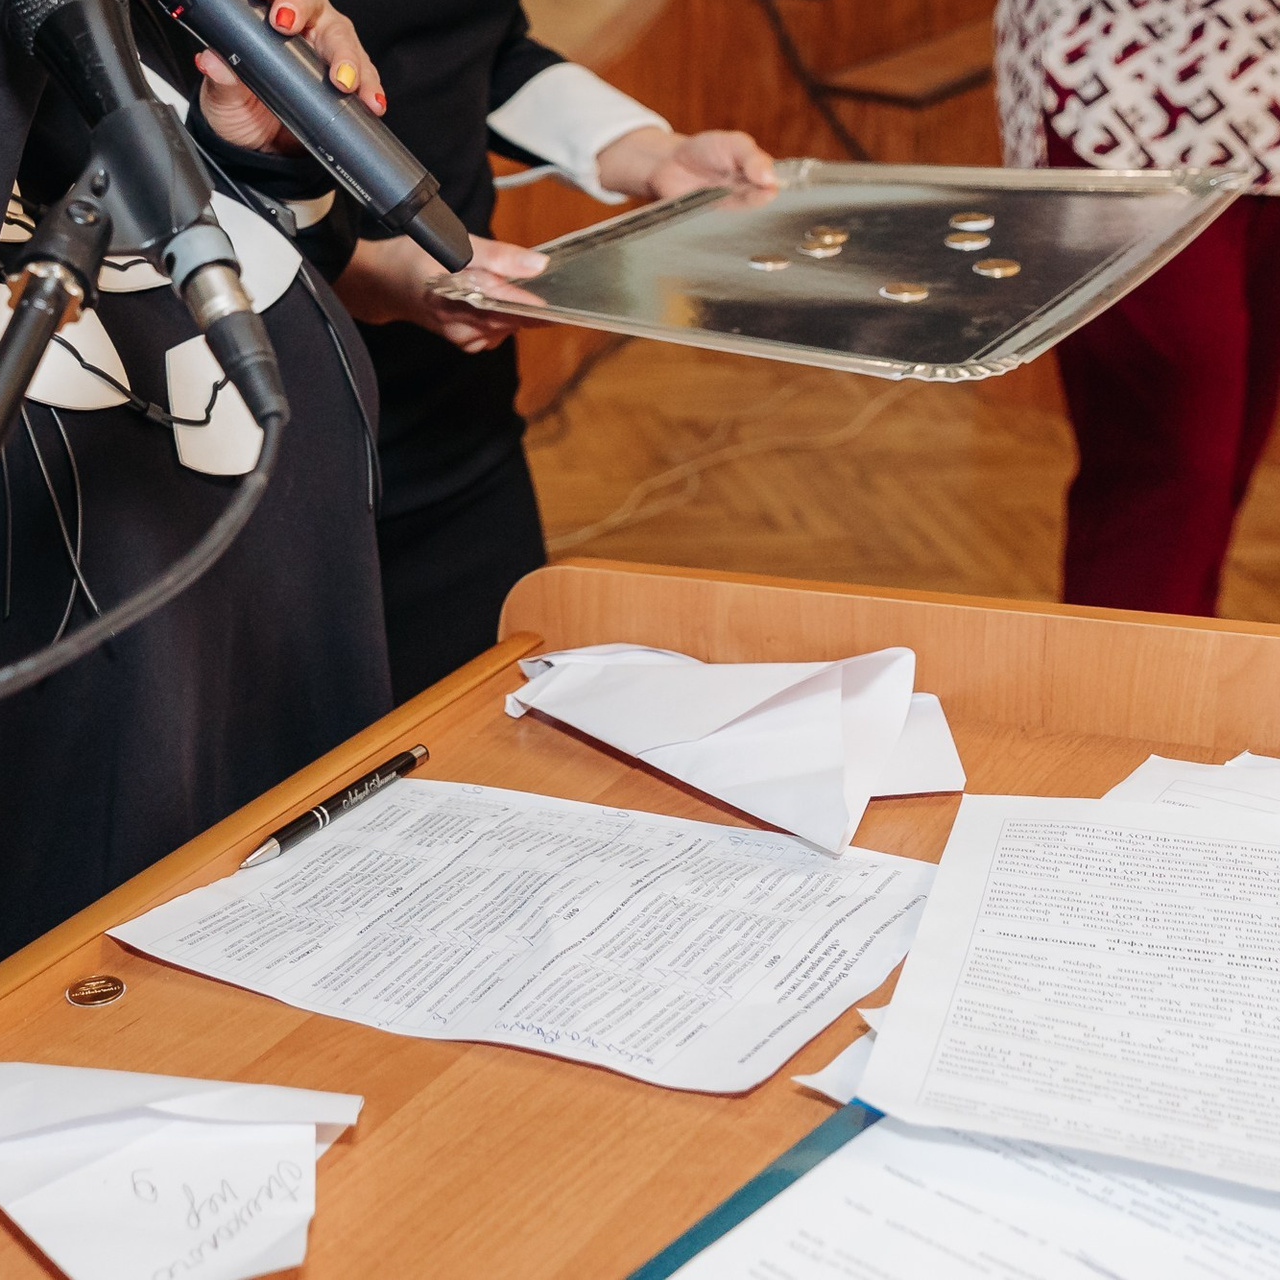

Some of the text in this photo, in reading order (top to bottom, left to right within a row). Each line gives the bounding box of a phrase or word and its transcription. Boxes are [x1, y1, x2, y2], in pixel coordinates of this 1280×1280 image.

[336, 164, 373, 202] SENNHEISER
[1008, 821, 1101, 833] «Нижегородский
[1006, 827, 1216, 853] начального образования факультета
[1128, 833, 1169, 843] ФГБОУ
[1173, 837, 1236, 848] педагогики
[1005, 833, 1252, 866] кафедры психологии педагогики
[1043, 849, 1111, 863] университет
[1063, 845, 1151, 861] педагогических
[999, 852, 1095, 870] «Нижегородский
[1118, 860, 1209, 876] педагогический
[1156, 857, 1207, 867] кандидат
[997, 858, 1213, 889] начального образования факультета
[1122, 869, 1165, 879] ФГБОУ
[1169, 873, 1234, 884] педагогики
[996, 866, 1250, 903] кафедры психологии педагогики
[1033, 892, 1104, 906] университет
[1090, 892, 1142, 904] кандидат
[562, 907, 581, 919] ФИО
[985, 902, 1209, 934] начального образования факультета
[988, 895, 1230, 929] педагогики ФГБОУ ВО «Нижегородский
[1111, 903, 1204, 920] педагогический
[984, 909, 1223, 946] кафедрой психологии педагогики
[855, 935, 877, 956] очного
[996, 930, 1095, 949] взаимодействие
[973, 945, 1048, 962] образования
[1147, 942, 1222, 958] социальной
[764, 954, 782, 968] ФИО
[841, 956, 859, 970] тура
[1006, 957, 1101, 977] педагогических
[1062, 958, 1101, 970] сферы
[772, 939, 842, 1005] «Мой первый учитель»
[796, 949, 850, 1000] начальной школы
[1107, 973, 1162, 985] кандидат
[1115, 966, 1173, 980] работник
[802, 972, 849, 1009] Всероссийской
[1044, 996, 1103, 1011] методики
[1130, 994, 1181, 1007] Москвы
[1189, 1000, 1232, 1012] города
[1128, 1009, 1214, 1027] департамента
